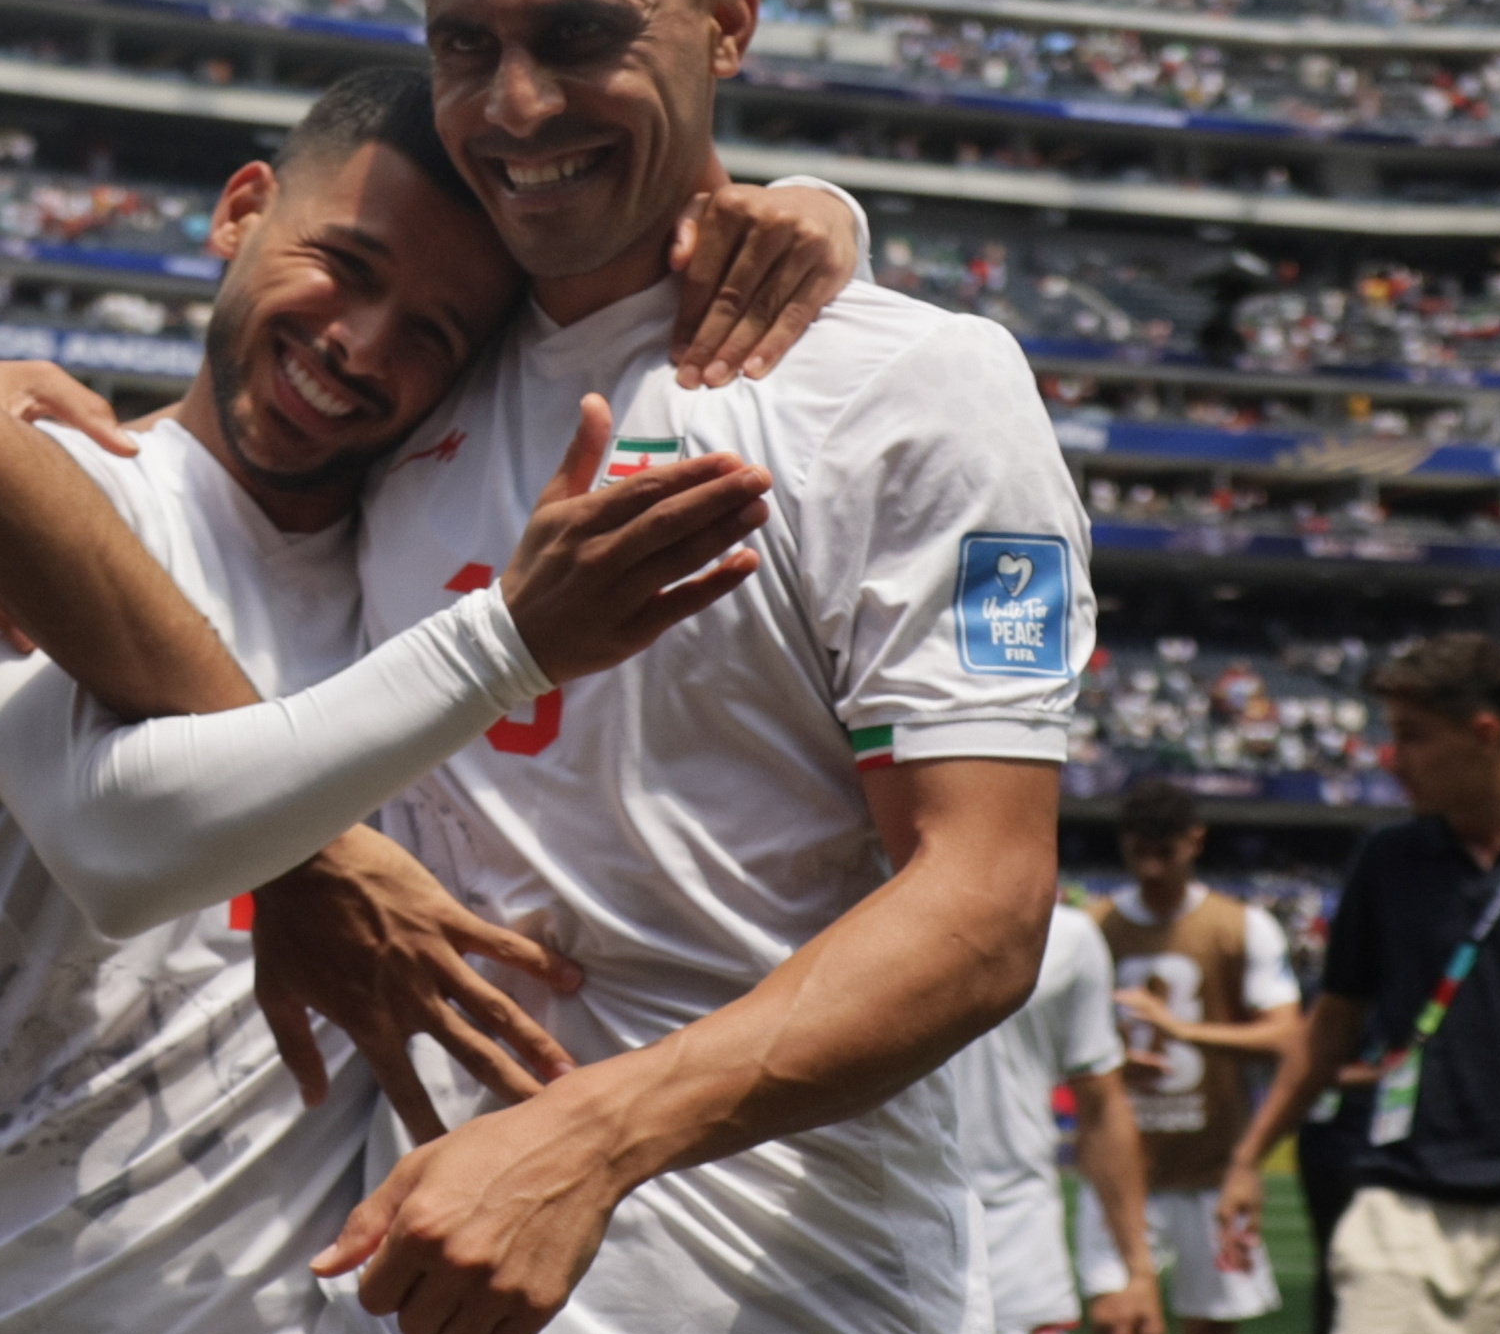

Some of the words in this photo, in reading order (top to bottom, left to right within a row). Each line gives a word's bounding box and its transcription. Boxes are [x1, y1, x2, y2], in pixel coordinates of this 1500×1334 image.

[982, 596, 1024, 621] Unite
[1023, 597, 1048, 620] For
[991, 620, 1044, 647] PEACE
[1005, 648, 1036, 662] FIFA
